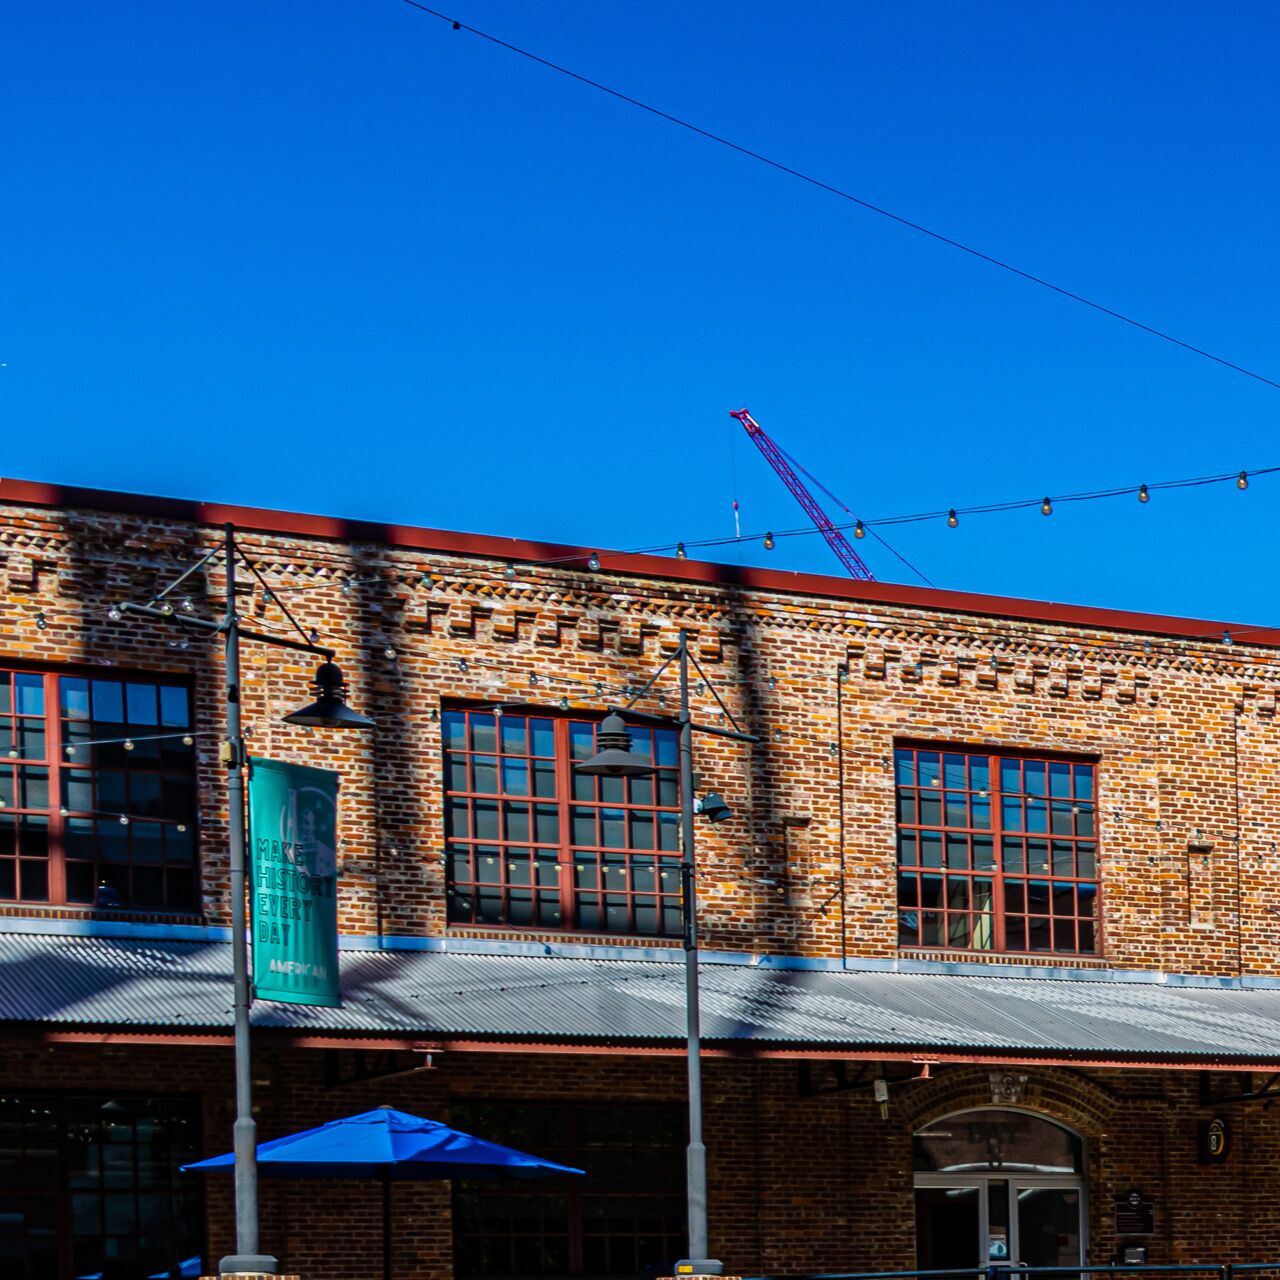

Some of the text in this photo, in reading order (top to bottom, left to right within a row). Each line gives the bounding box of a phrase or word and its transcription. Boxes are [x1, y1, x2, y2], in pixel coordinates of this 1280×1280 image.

[256, 837, 304, 866] MAKE
[256, 865, 335, 898] HISTORY
[258, 892, 313, 922] EVERY
[259, 920, 291, 946] DAY
